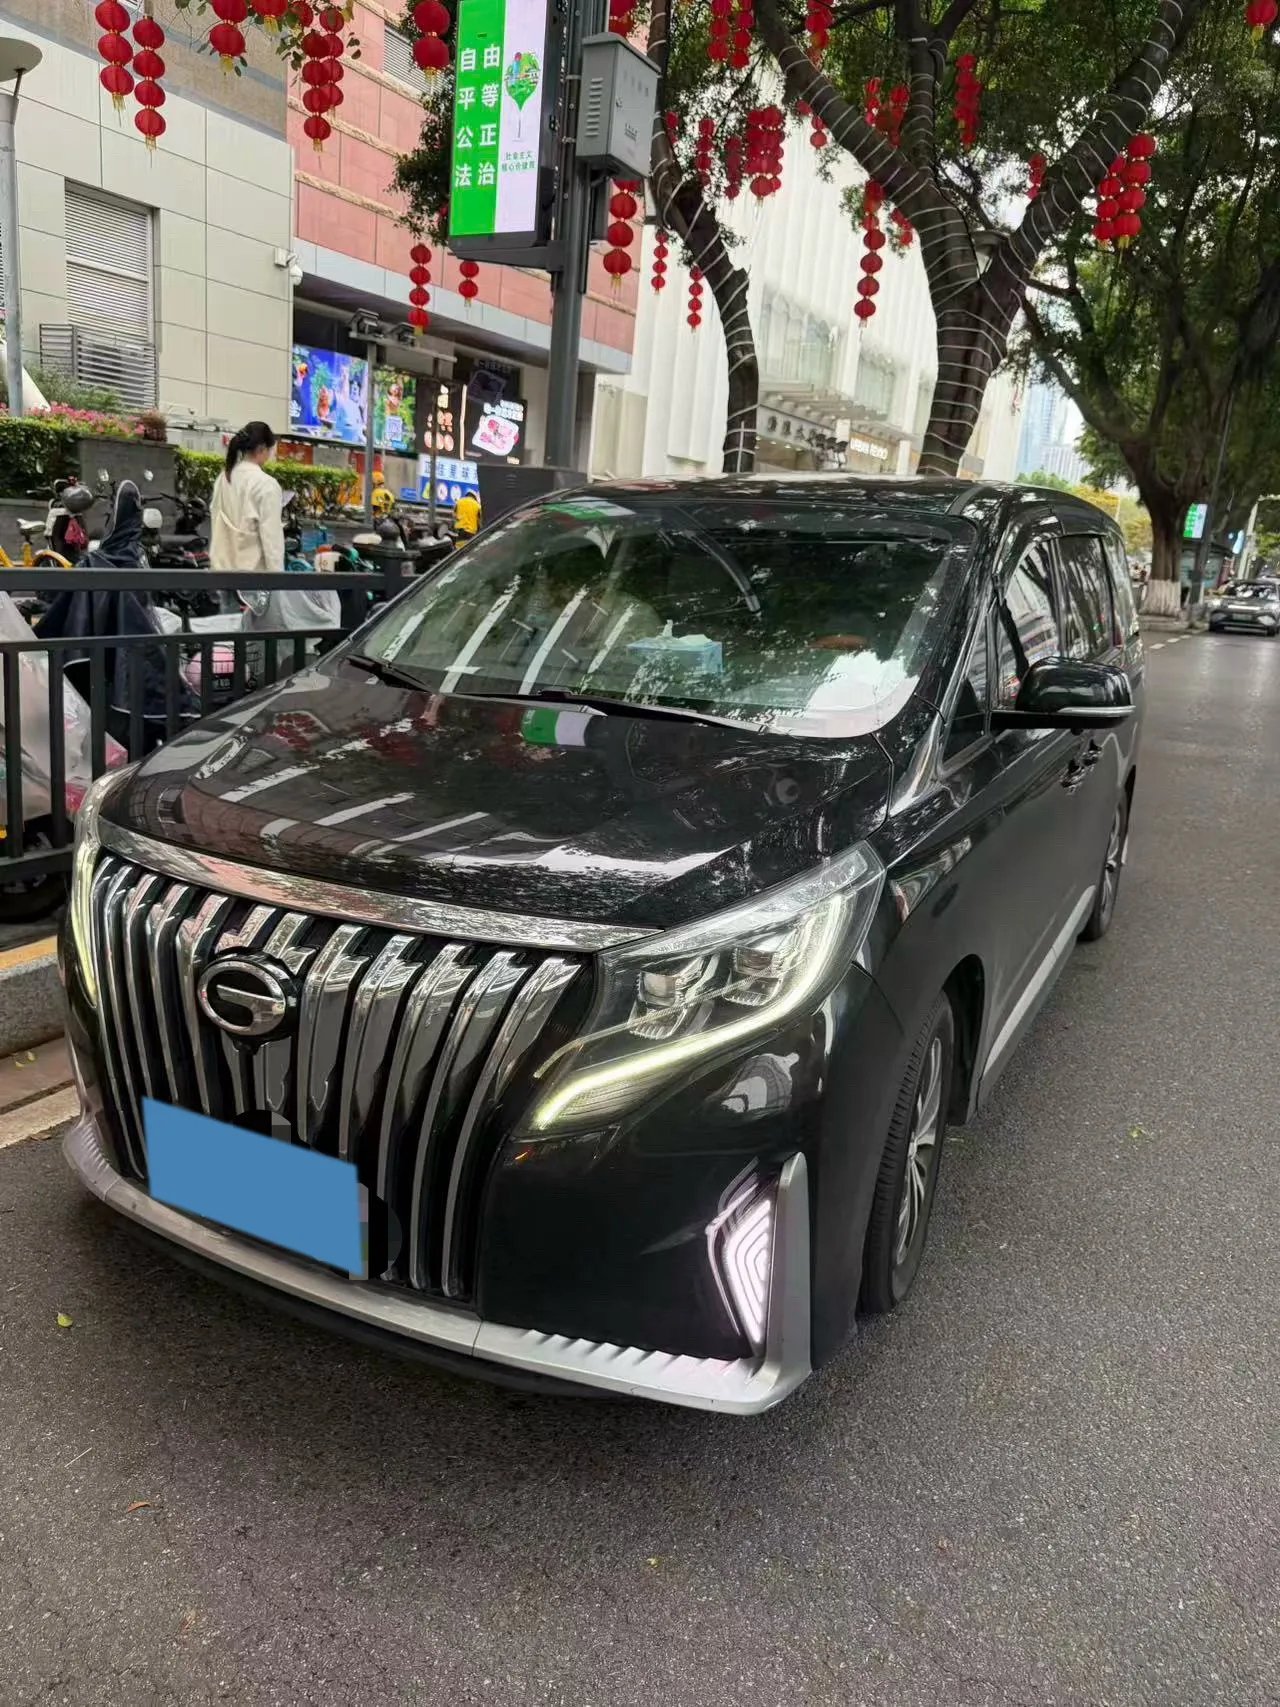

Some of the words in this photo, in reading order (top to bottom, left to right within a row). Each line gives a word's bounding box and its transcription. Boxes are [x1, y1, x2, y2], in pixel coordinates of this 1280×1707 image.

[460, 44, 500, 72] 自由
[458, 83, 499, 110] 平等
[456, 123, 497, 149] 公正
[454, 162, 495, 187] 法治
